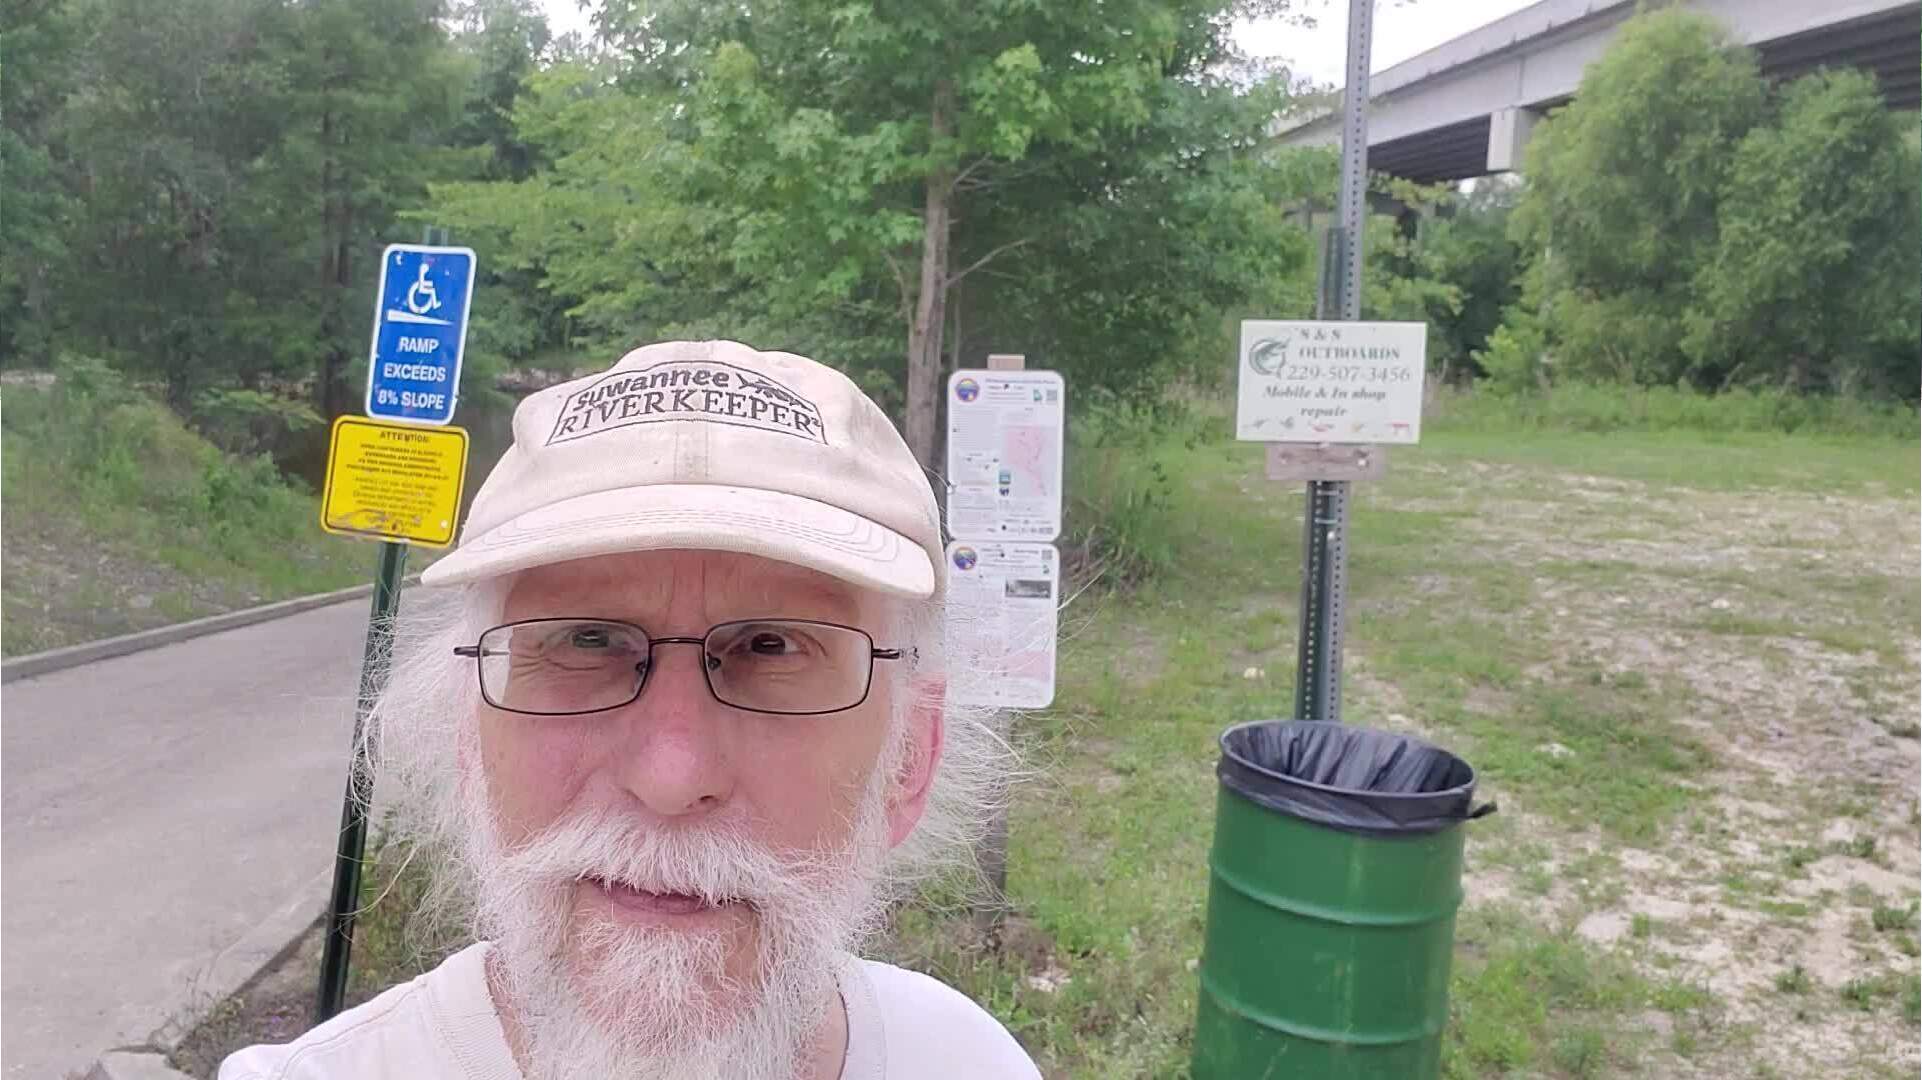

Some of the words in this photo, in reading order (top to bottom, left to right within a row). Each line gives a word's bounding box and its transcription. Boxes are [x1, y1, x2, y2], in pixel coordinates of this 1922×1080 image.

[1300, 328, 1309, 340] S
[1314, 328, 1326, 340] &
[1332, 328, 1342, 340] S
[398, 336, 440, 354] RAMP
[1298, 346, 1401, 360] OUTBOARDS
[383, 362, 447, 382] EXCEEDS
[1286, 365, 1411, 382] 229-507-3456
[377, 389, 398, 405] 8%
[401, 391, 446, 410] SLOPE
[1263, 385, 1311, 398] Mobile
[1315, 387, 1326, 398] &
[1332, 386, 1348, 399] In
[1352, 386, 1387, 401] shop
[1300, 405, 1348, 419] repair
